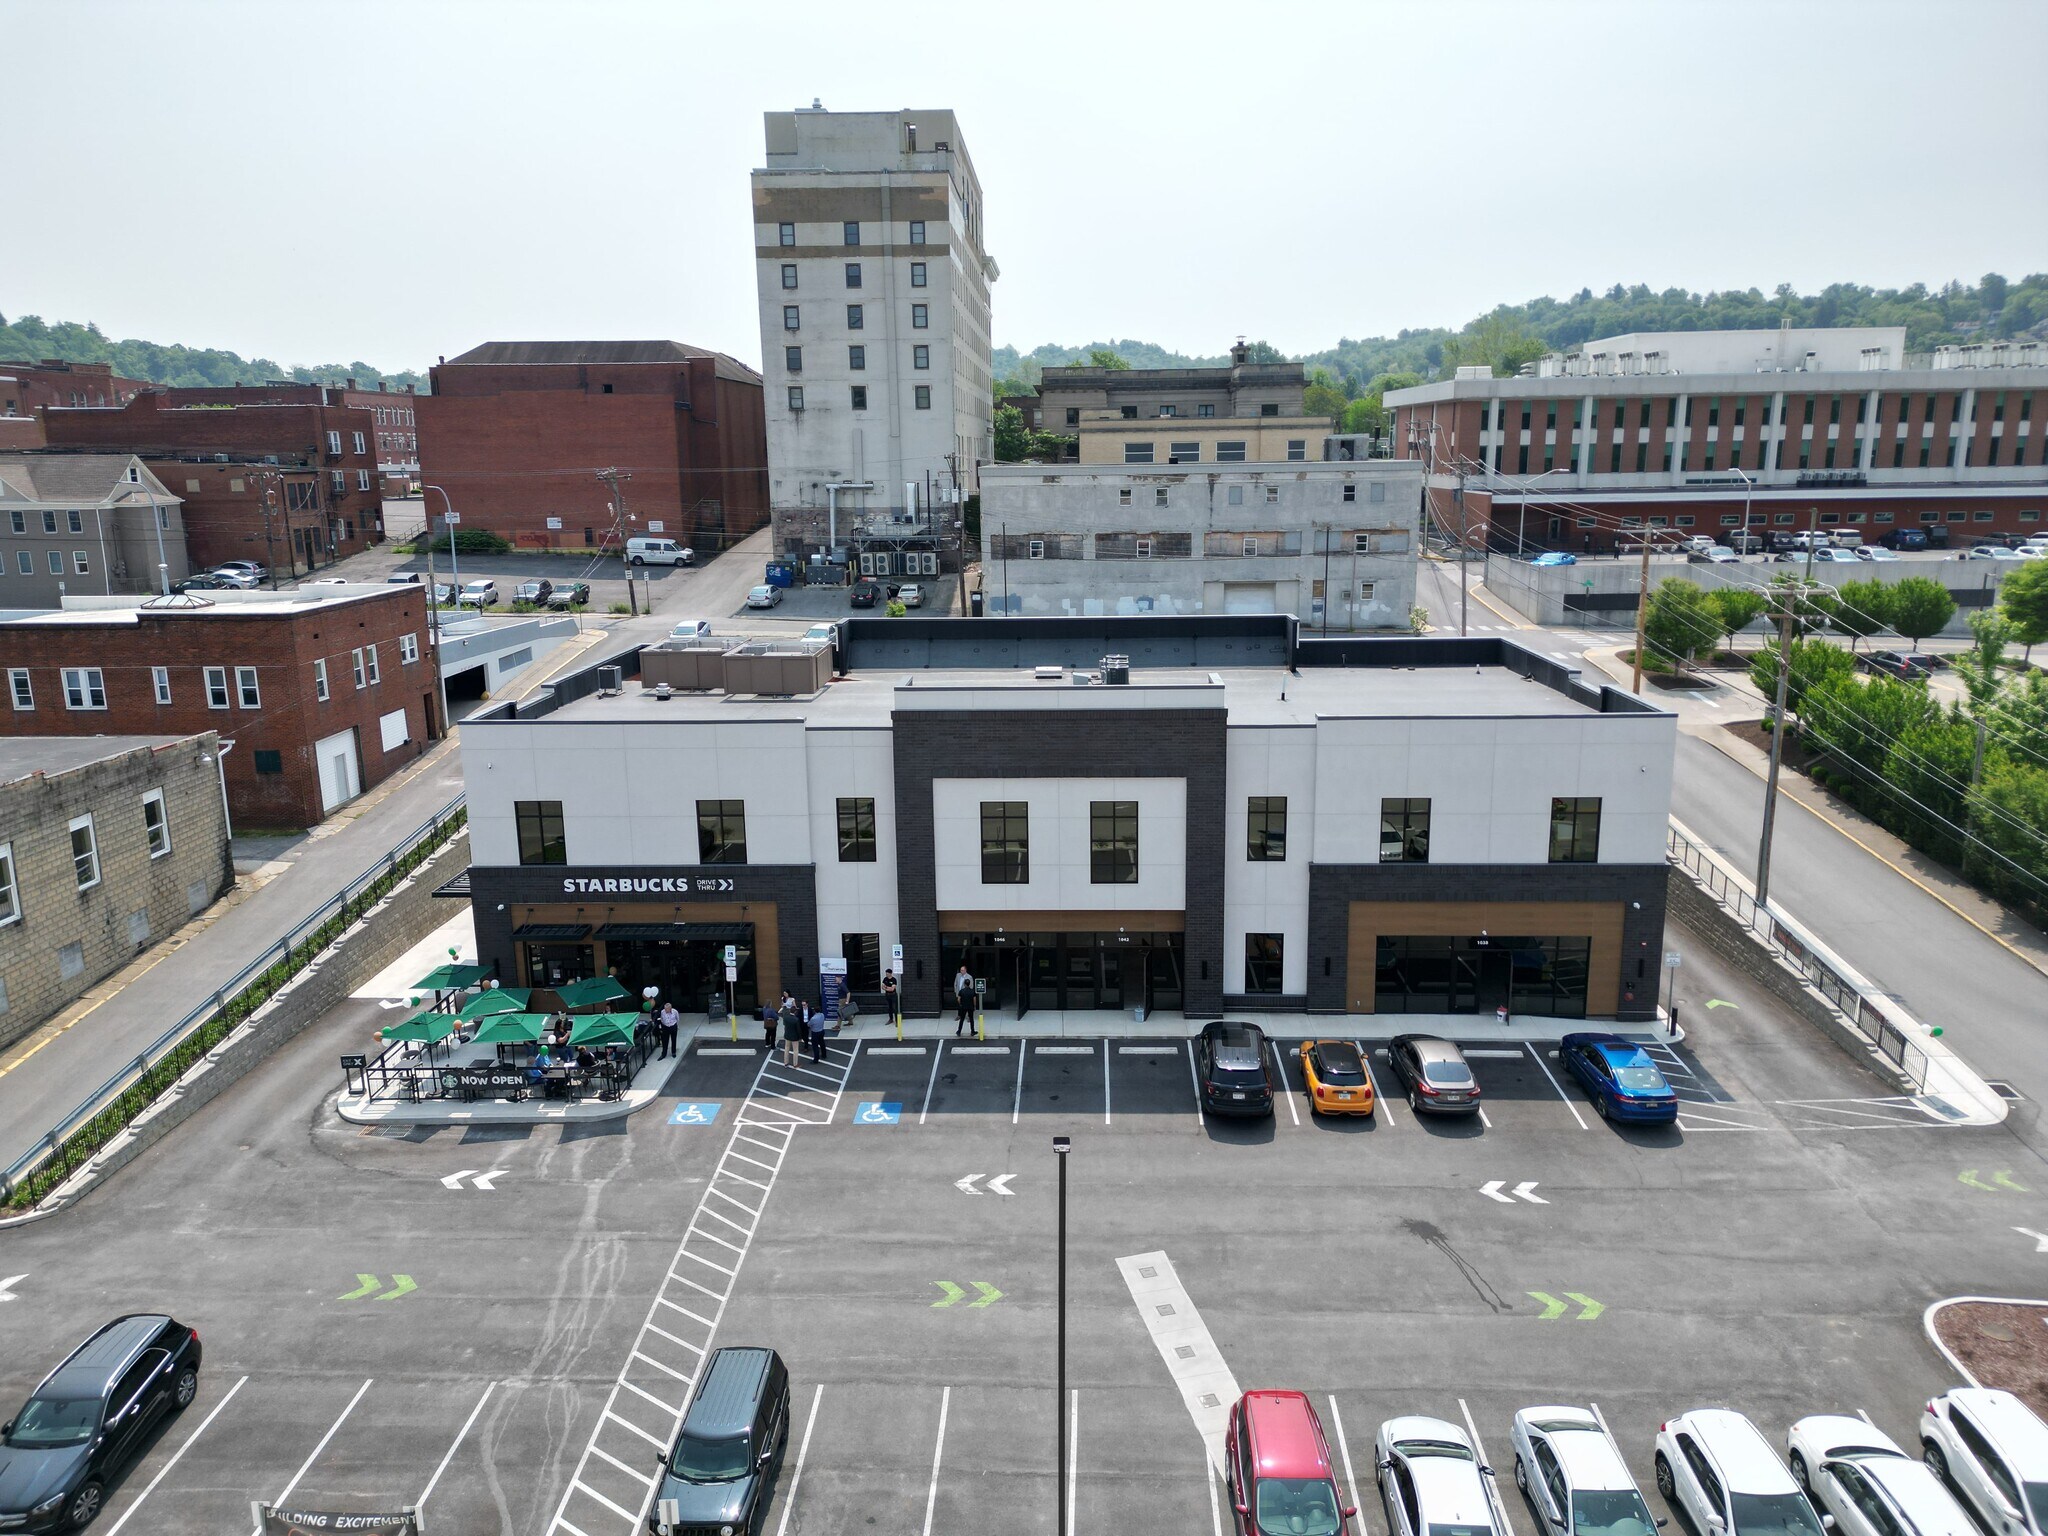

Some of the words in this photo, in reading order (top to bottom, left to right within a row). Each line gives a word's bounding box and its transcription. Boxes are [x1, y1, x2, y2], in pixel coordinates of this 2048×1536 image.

[564, 878, 688, 892] STARBUCKS
[461, 1076, 488, 1085] NOW
[491, 1076, 523, 1085] OPEN
[335, 1514, 417, 1528] EXCITEMENT
